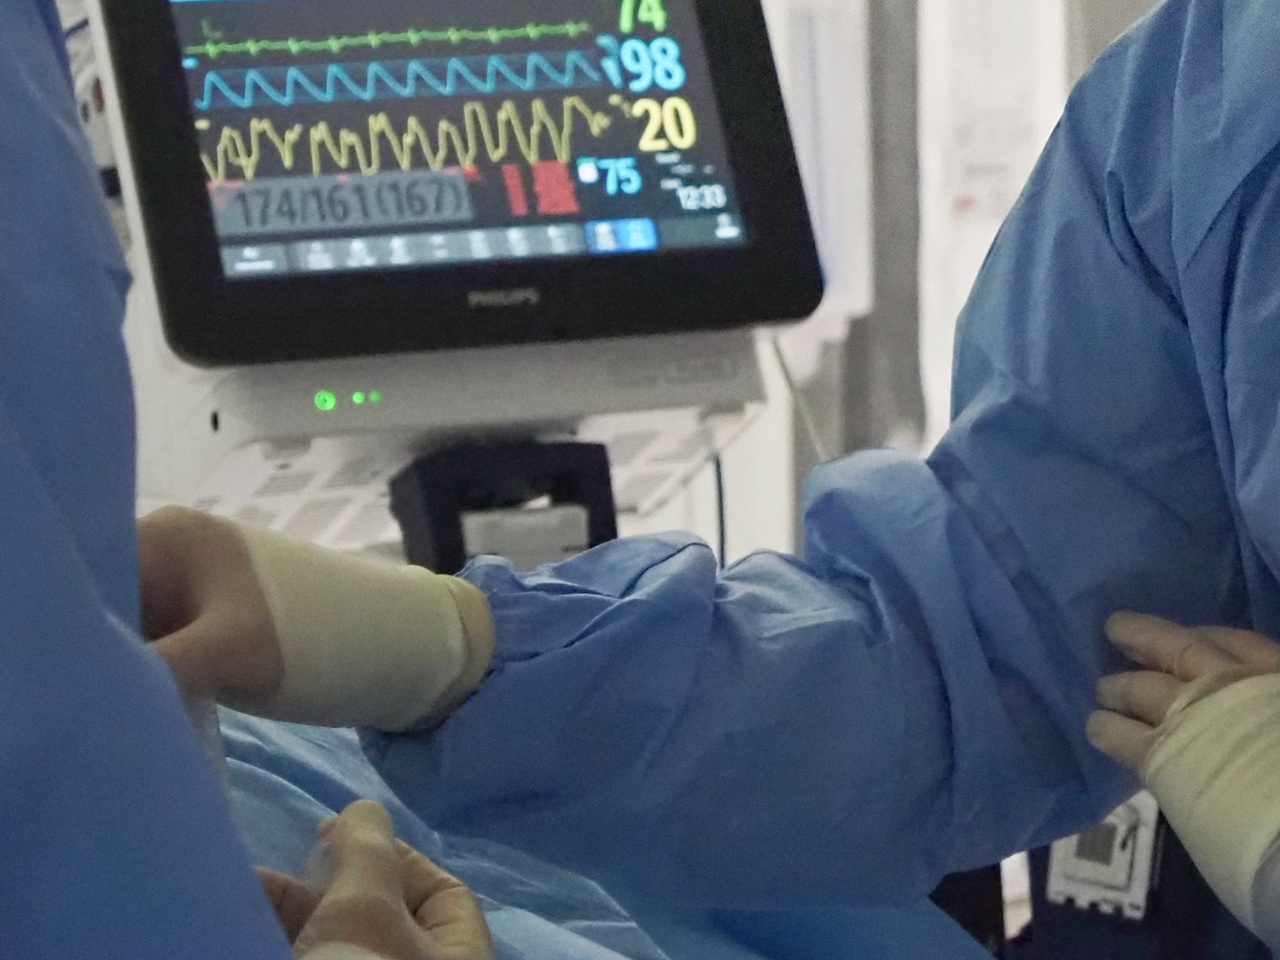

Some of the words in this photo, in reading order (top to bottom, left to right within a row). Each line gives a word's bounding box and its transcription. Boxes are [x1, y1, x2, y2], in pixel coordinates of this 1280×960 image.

[620, 36, 687, 93] 98
[631, 96, 698, 152] 20
[598, 156, 643, 195] 75
